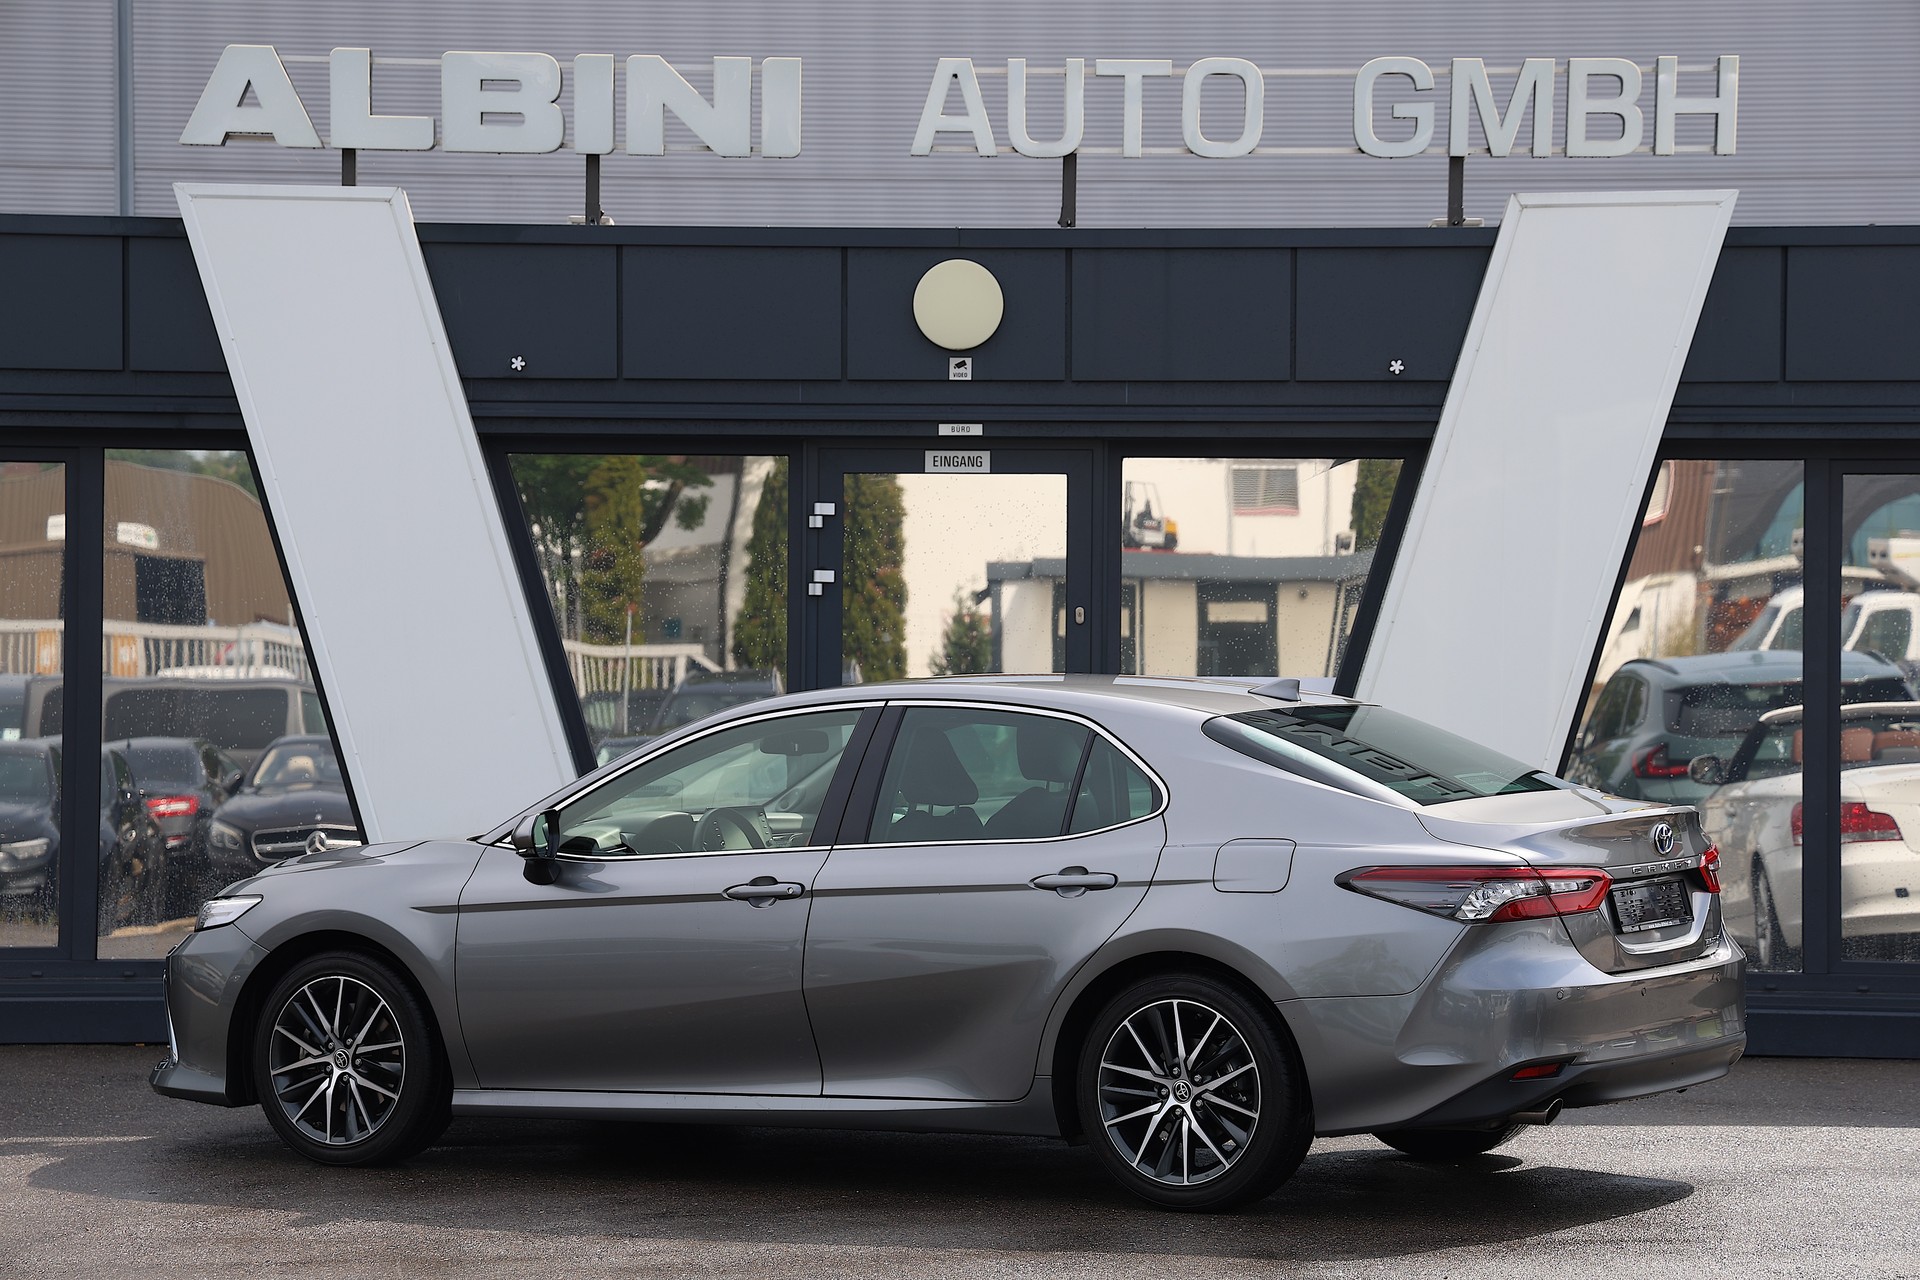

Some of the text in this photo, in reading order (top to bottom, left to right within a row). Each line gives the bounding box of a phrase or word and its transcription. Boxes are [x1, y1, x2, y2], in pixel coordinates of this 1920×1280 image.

[179, 44, 1740, 159] ALBINI AUTO GMBH
[950, 425, 971, 433] BÜRO
[932, 455, 983, 468] EINGANG
